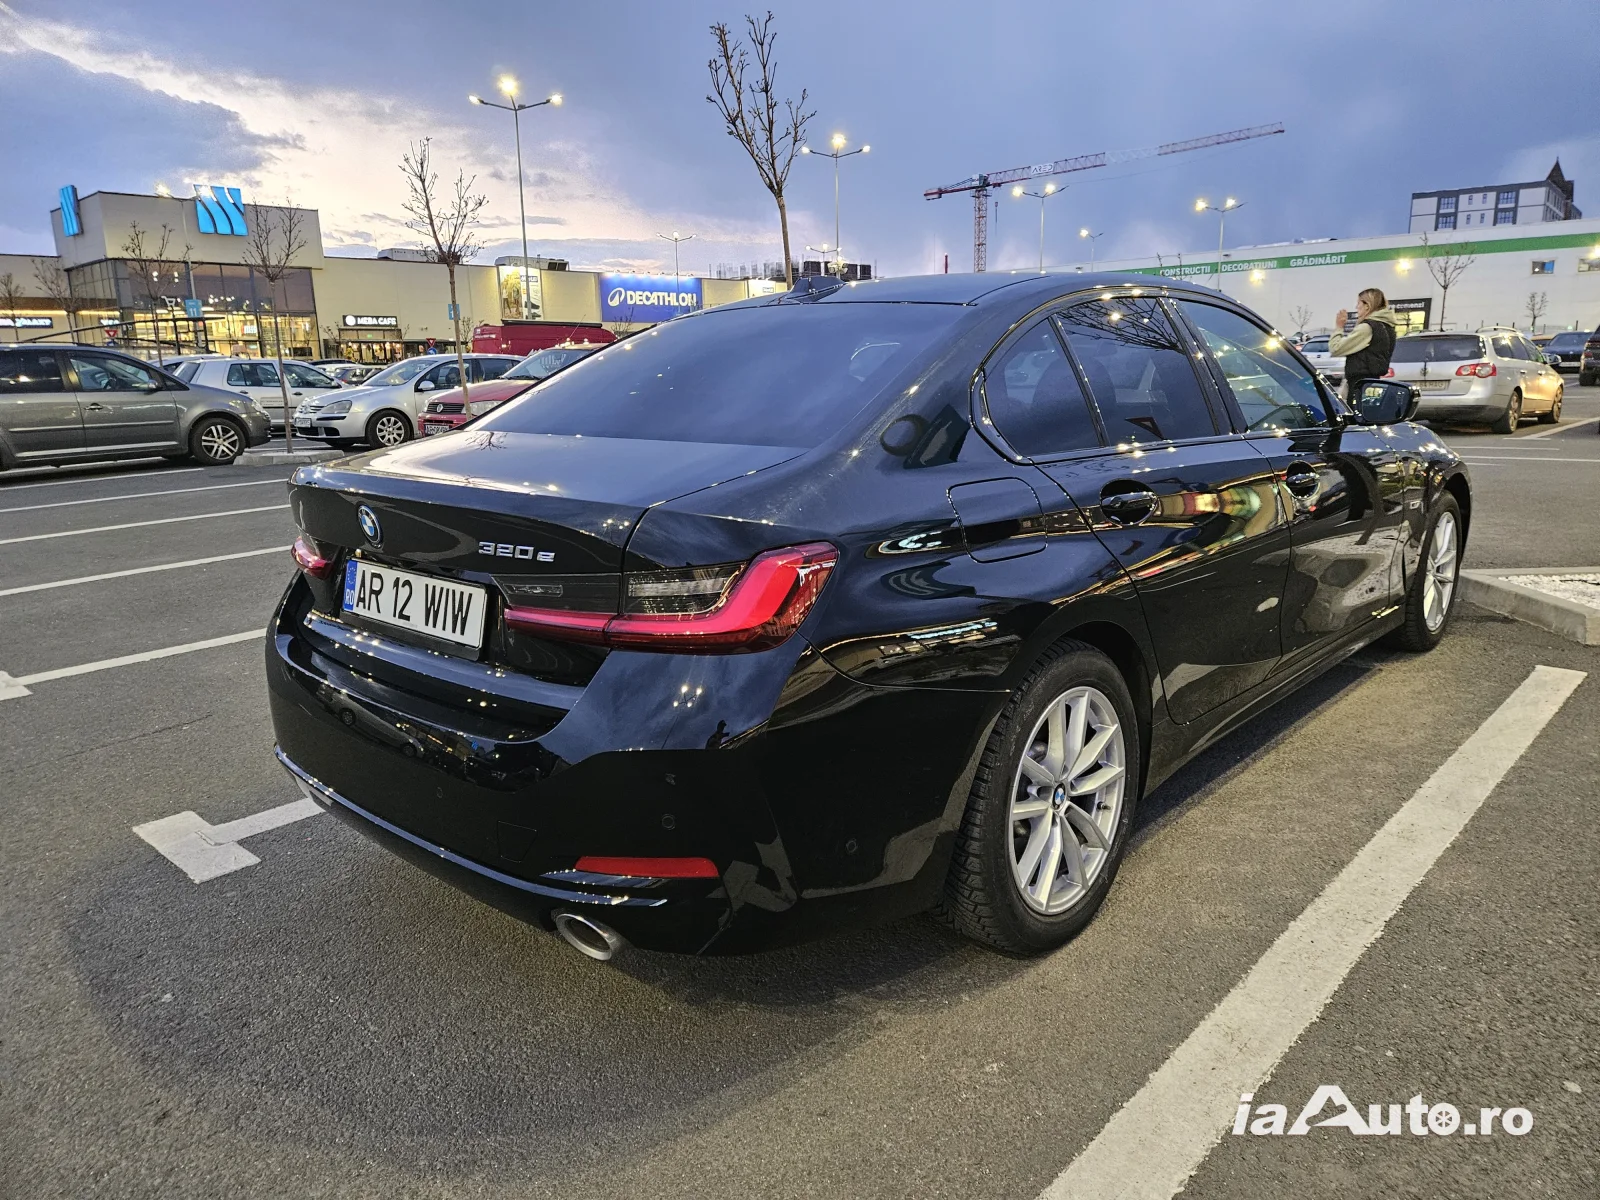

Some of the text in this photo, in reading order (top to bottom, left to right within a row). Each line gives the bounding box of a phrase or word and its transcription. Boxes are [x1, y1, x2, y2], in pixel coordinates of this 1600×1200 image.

[1289, 254, 1347, 268] GRĂDINĂRIT
[626, 290, 697, 307] DECATHLON
[478, 541, 535, 560] 320
[344, 588, 355, 606] RO
[356, 570, 473, 637] AR 12 WIW
